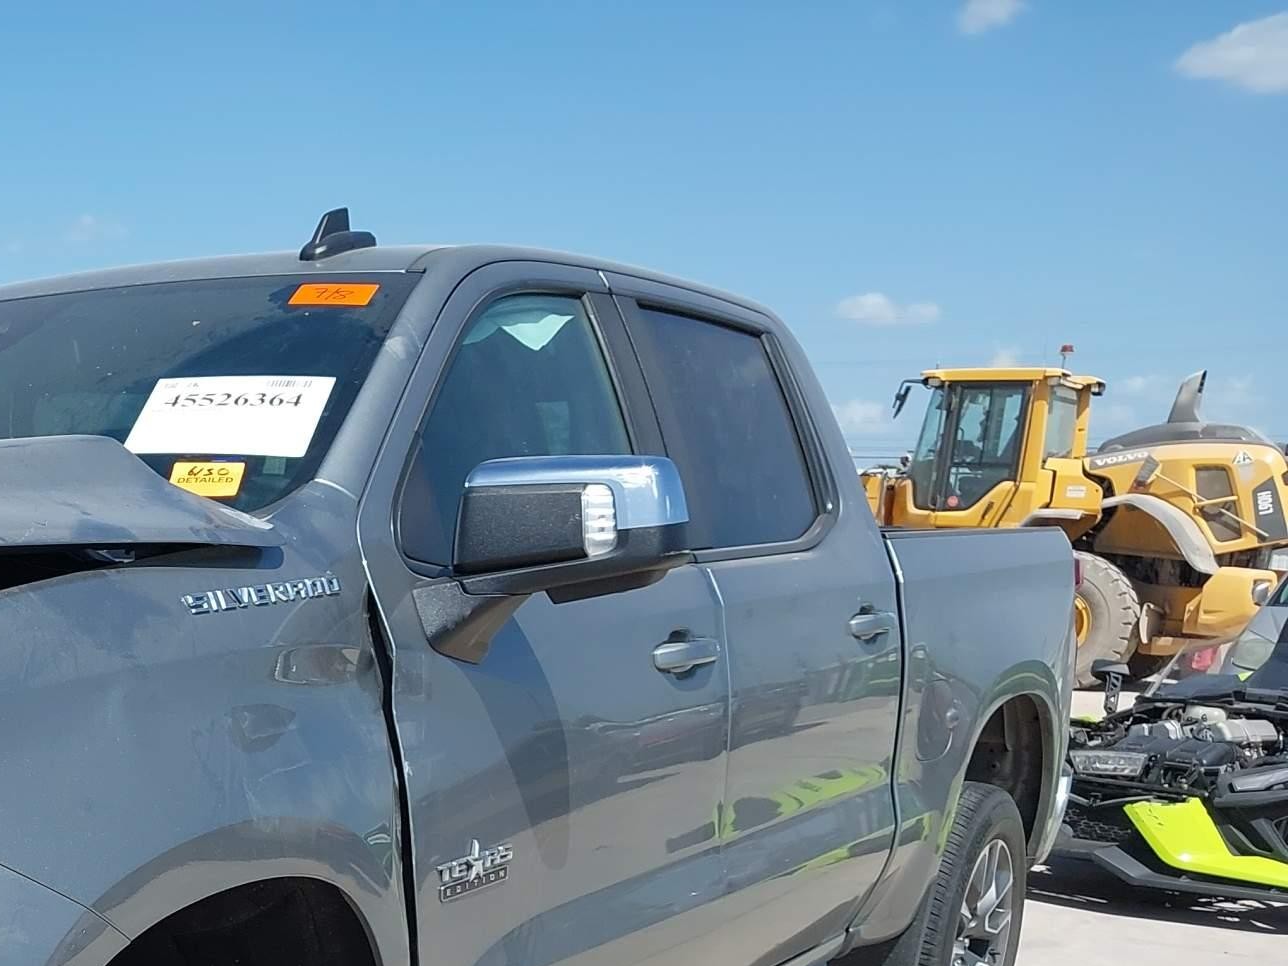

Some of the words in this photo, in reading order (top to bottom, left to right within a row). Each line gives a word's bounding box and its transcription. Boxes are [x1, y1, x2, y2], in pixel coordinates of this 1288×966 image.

[164, 392, 303, 408] 45526364
[1094, 451, 1149, 466] VOLVO
[177, 476, 234, 484] DETAILED
[1256, 490, 1274, 516] L90H
[180, 573, 341, 614] SILVERADO
[436, 840, 513, 883] TEXAS
[446, 869, 506, 896] EDITION
